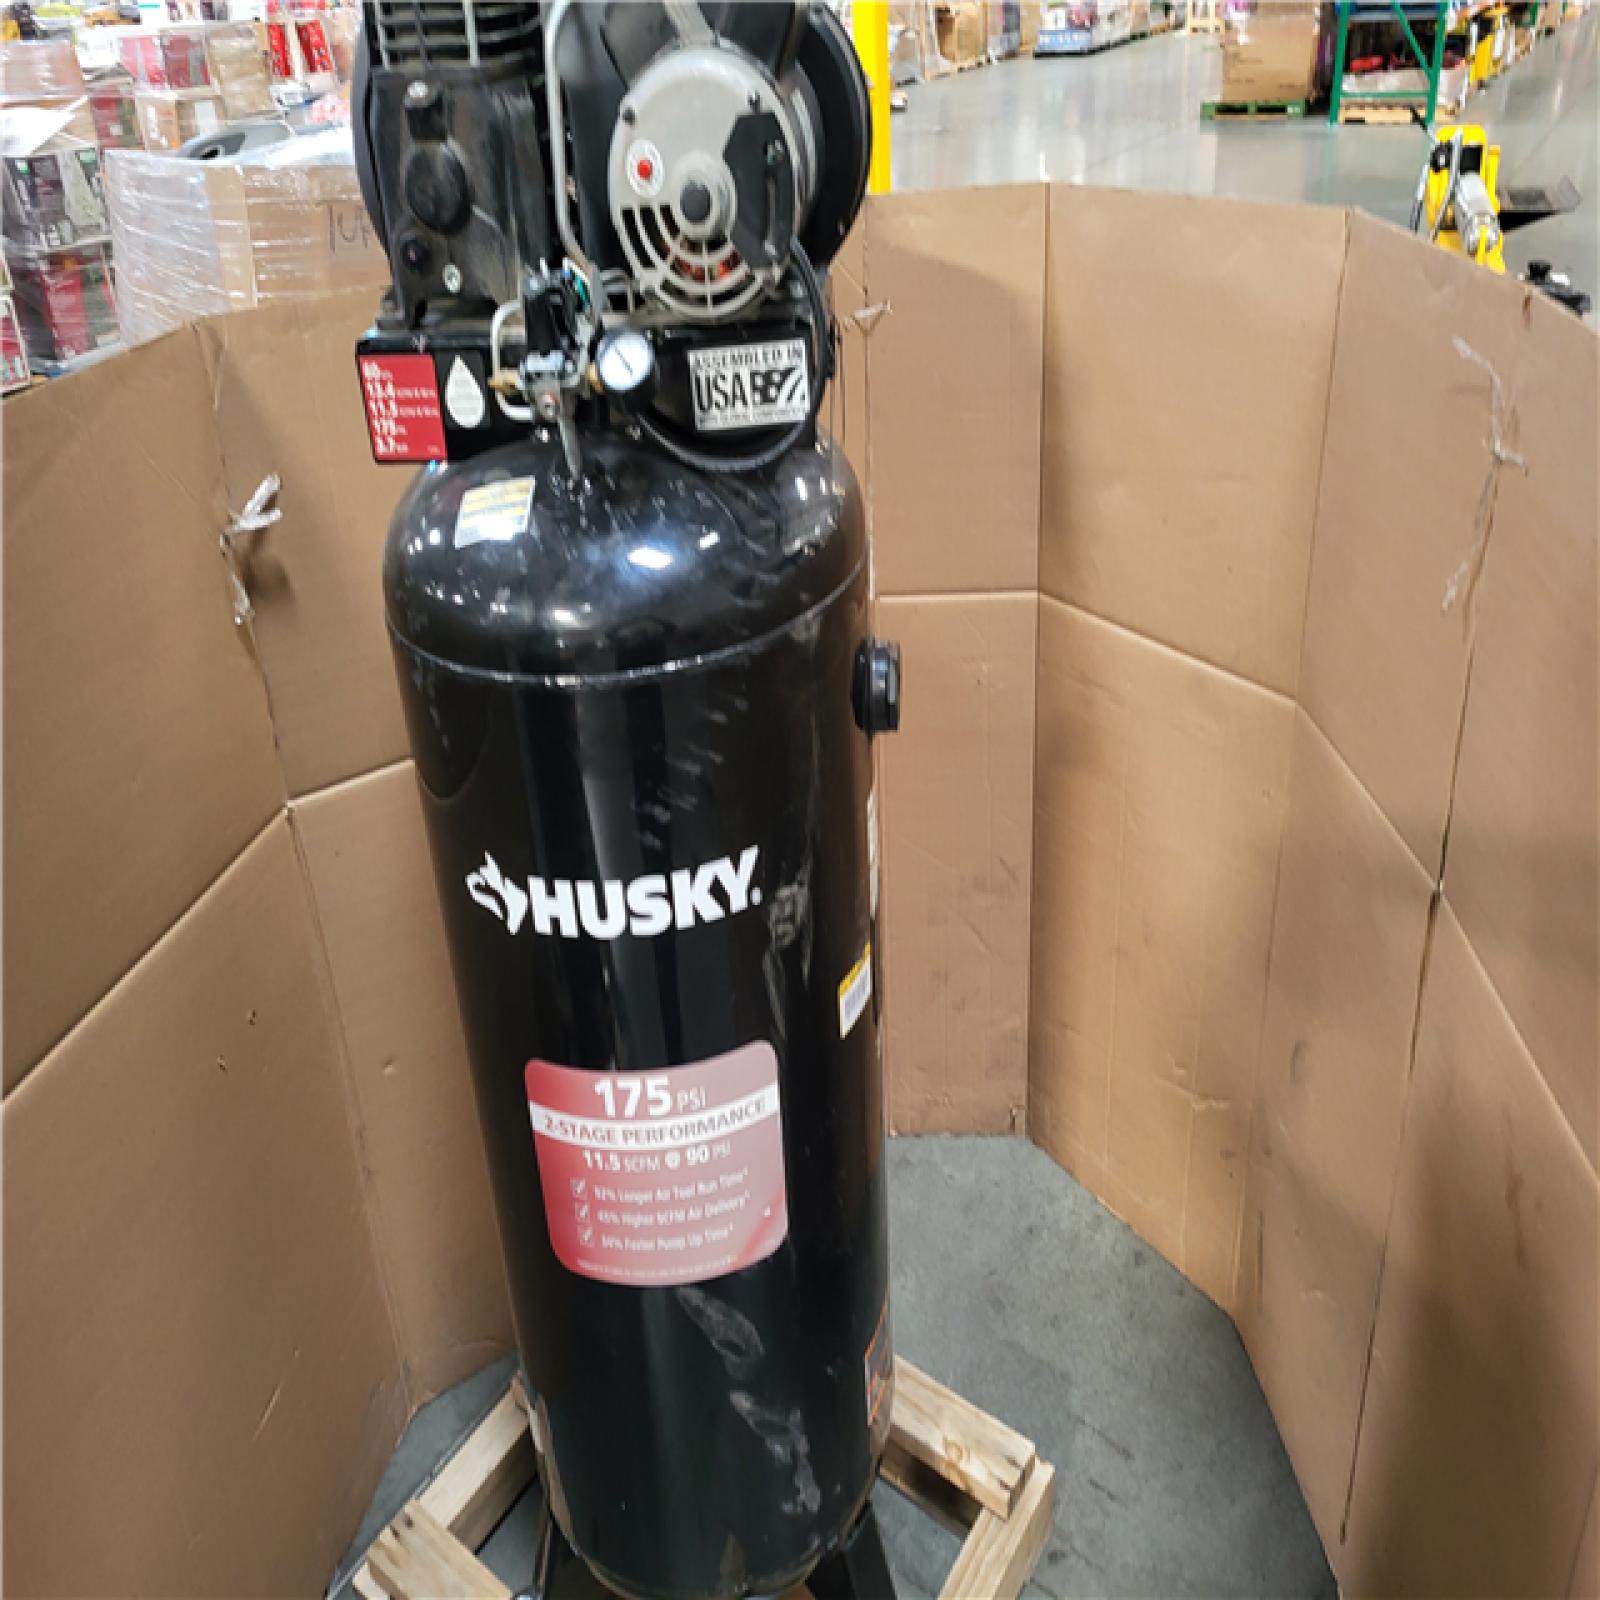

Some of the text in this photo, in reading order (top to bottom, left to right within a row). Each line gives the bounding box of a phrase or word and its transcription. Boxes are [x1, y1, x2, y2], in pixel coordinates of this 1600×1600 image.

[694, 371, 749, 412] USA
[526, 845, 760, 940] HUSKY
[594, 1076, 707, 1119] 175 PSI
[544, 1098, 766, 1146] 2-STAGE PERFORMANCE
[582, 1149, 621, 1171] 11.5
[623, 1152, 661, 1174] SCFM
[685, 1144, 710, 1166] 90
